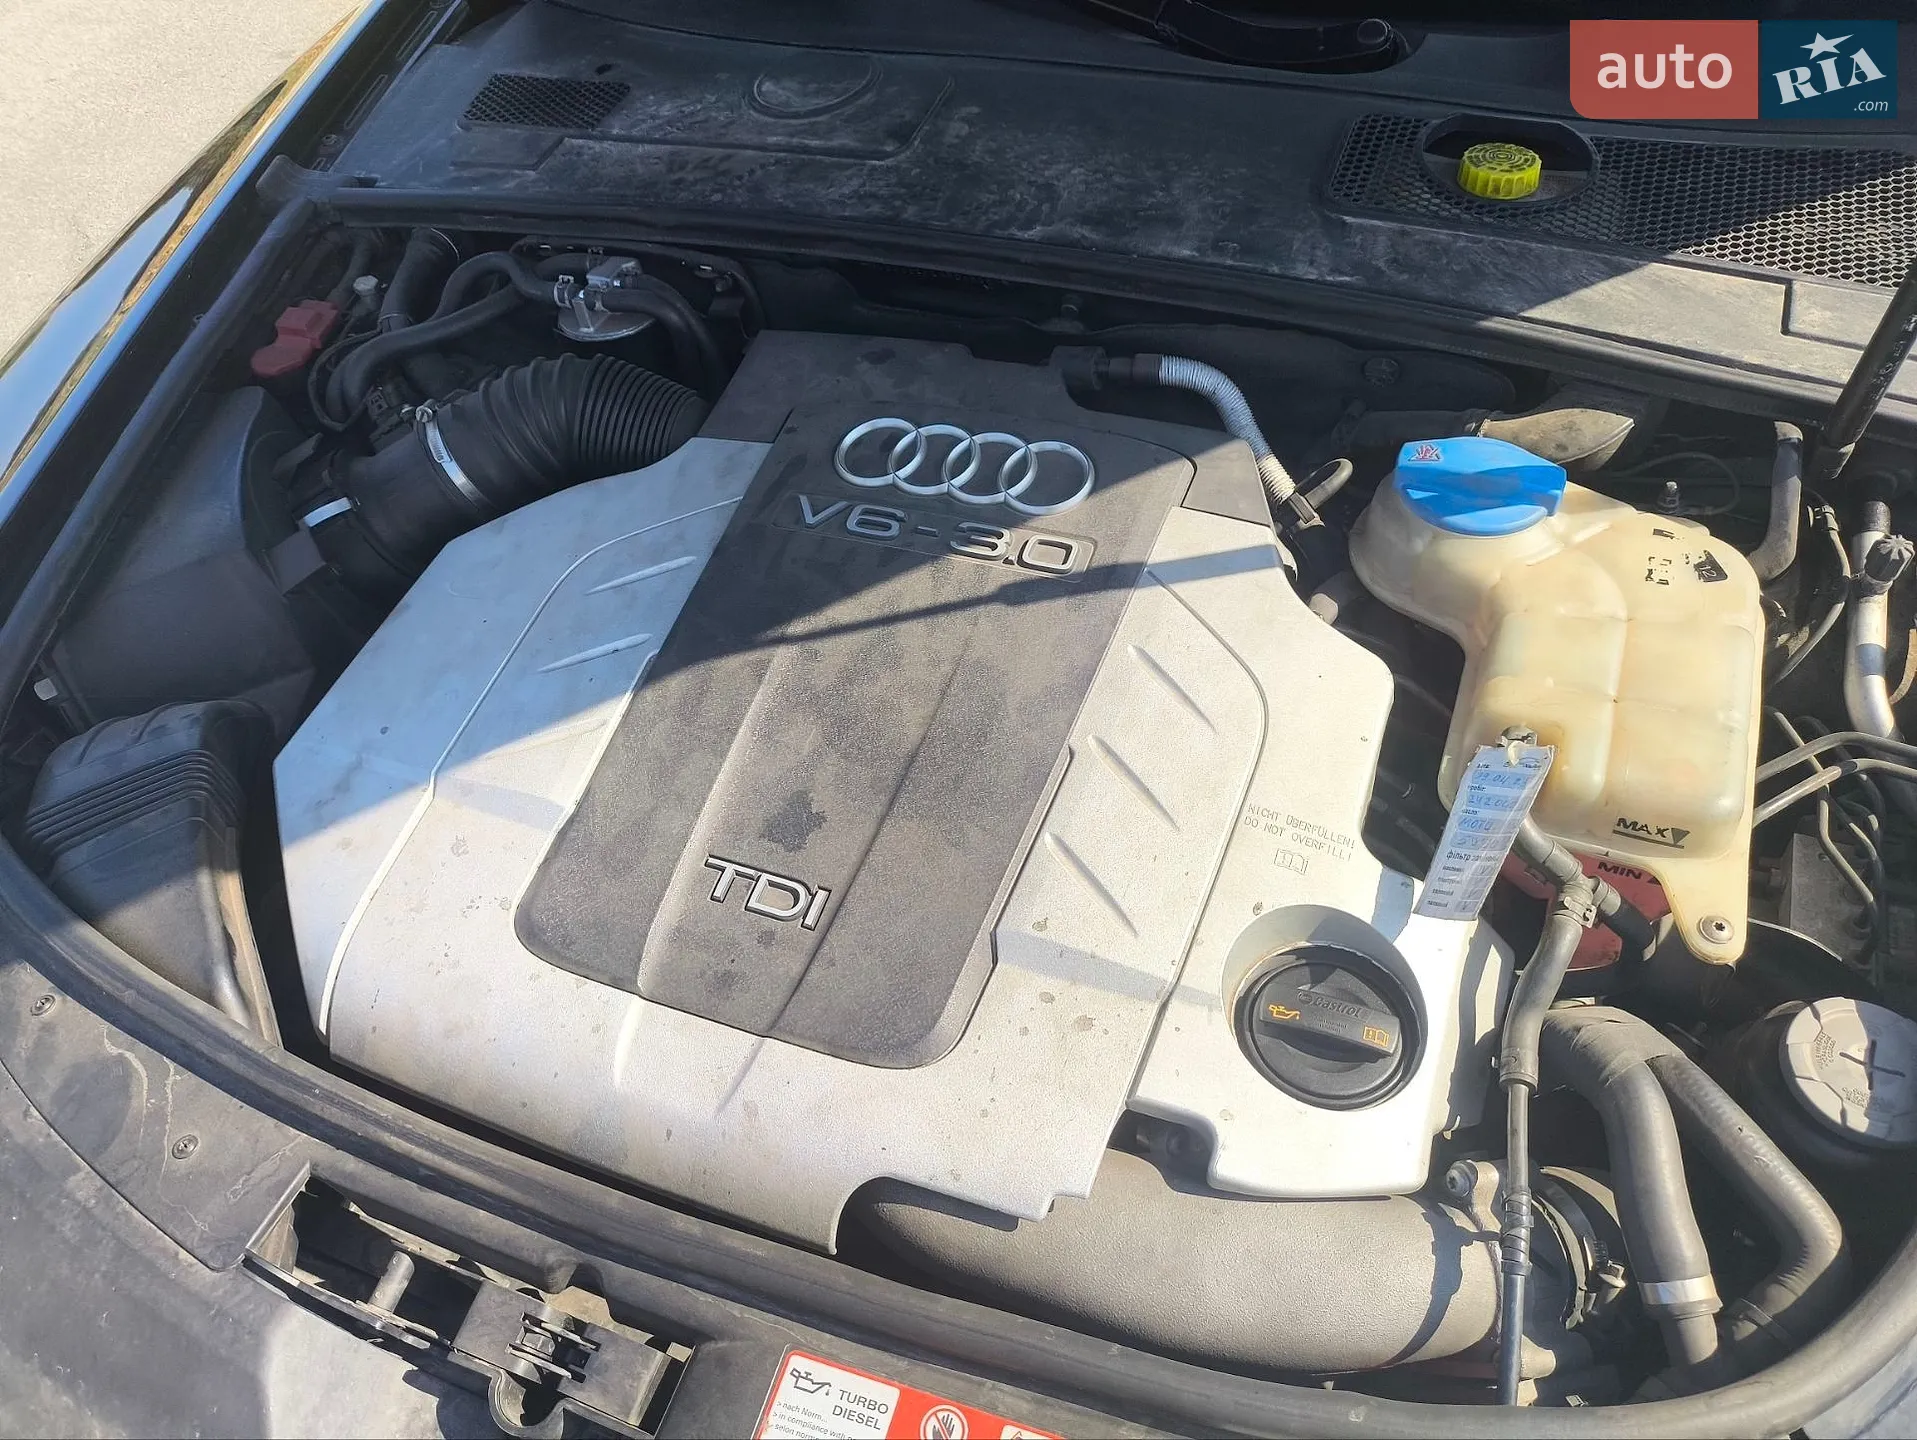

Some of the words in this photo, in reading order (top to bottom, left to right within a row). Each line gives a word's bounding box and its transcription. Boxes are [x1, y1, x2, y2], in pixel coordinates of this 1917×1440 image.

[1248, 804, 1281, 821] NICHT
[1244, 816, 1259, 828] DO
[1264, 823, 1286, 837] NOT
[1616, 818, 1669, 838] MAX
[1597, 861, 1642, 879] MIN
[704, 854, 832, 931] TDI
[839, 1389, 889, 1415] TURBO
[832, 1405, 881, 1430] DIESEL
